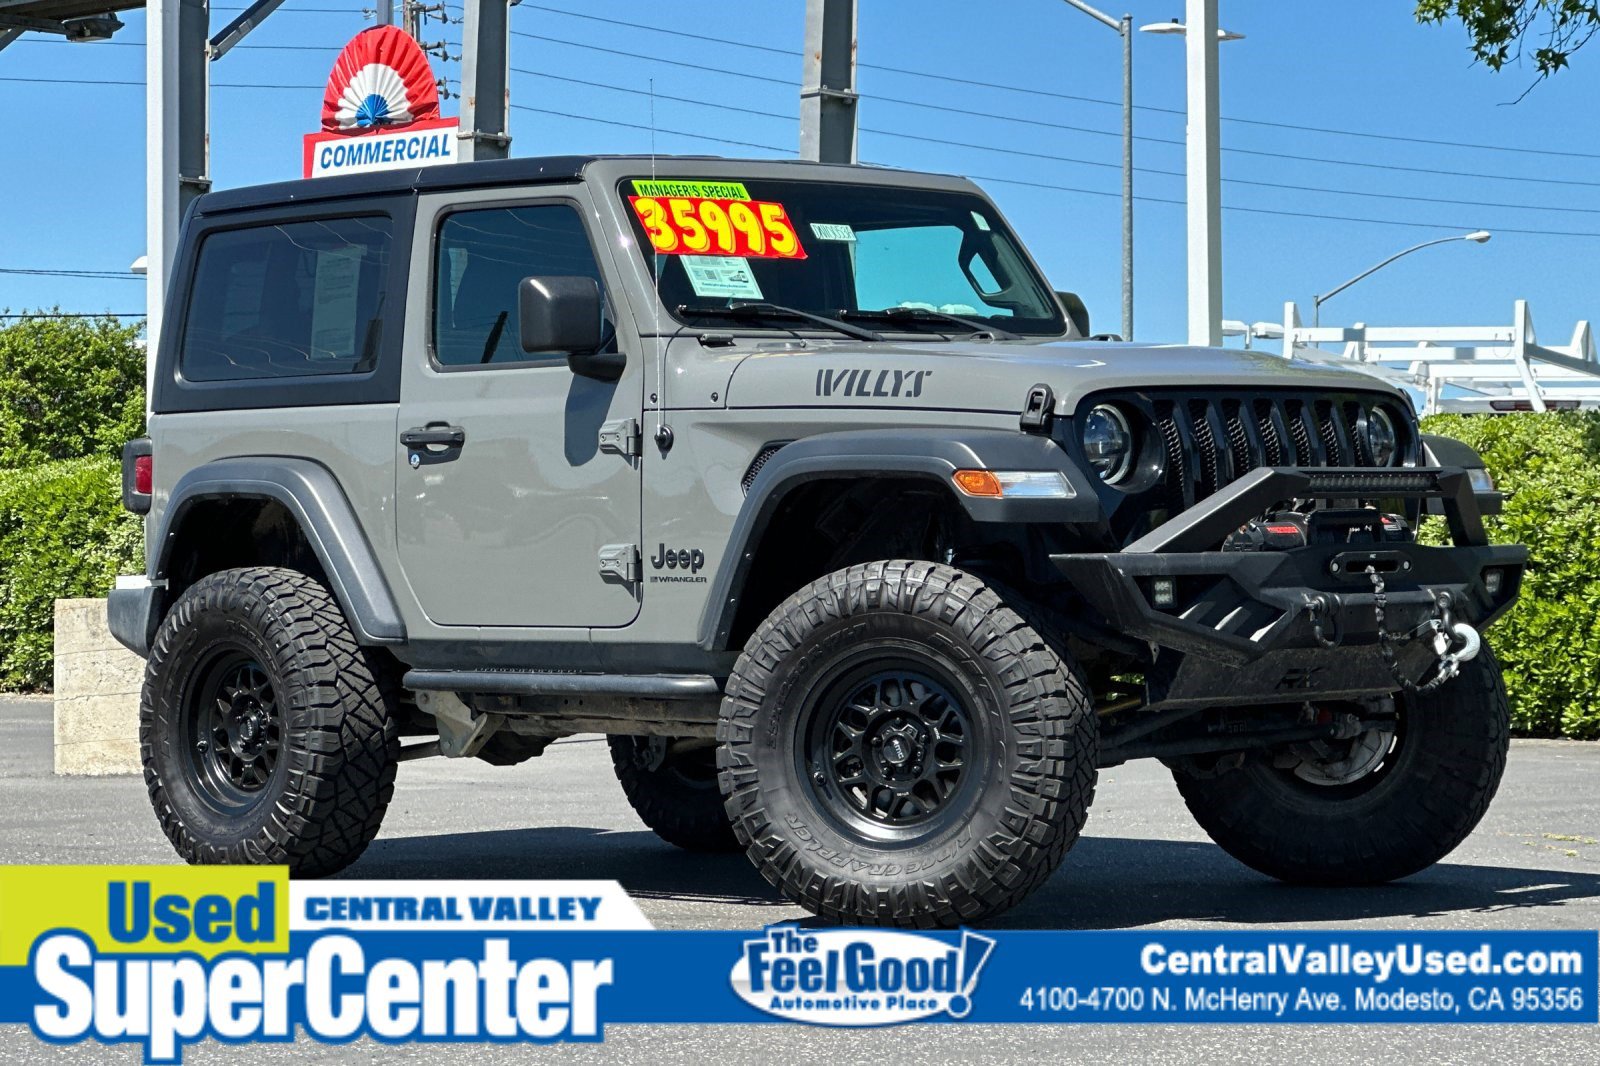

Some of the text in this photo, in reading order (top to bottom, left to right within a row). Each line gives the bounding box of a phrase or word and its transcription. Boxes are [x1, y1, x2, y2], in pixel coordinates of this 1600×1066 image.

[320, 133, 451, 169] COMMERCIAL
[639, 184, 745, 199] MANAGER'S SPECIAL
[634, 197, 799, 256] 35995
[815, 369, 933, 398] WILLYS
[650, 543, 705, 574] Jeep
